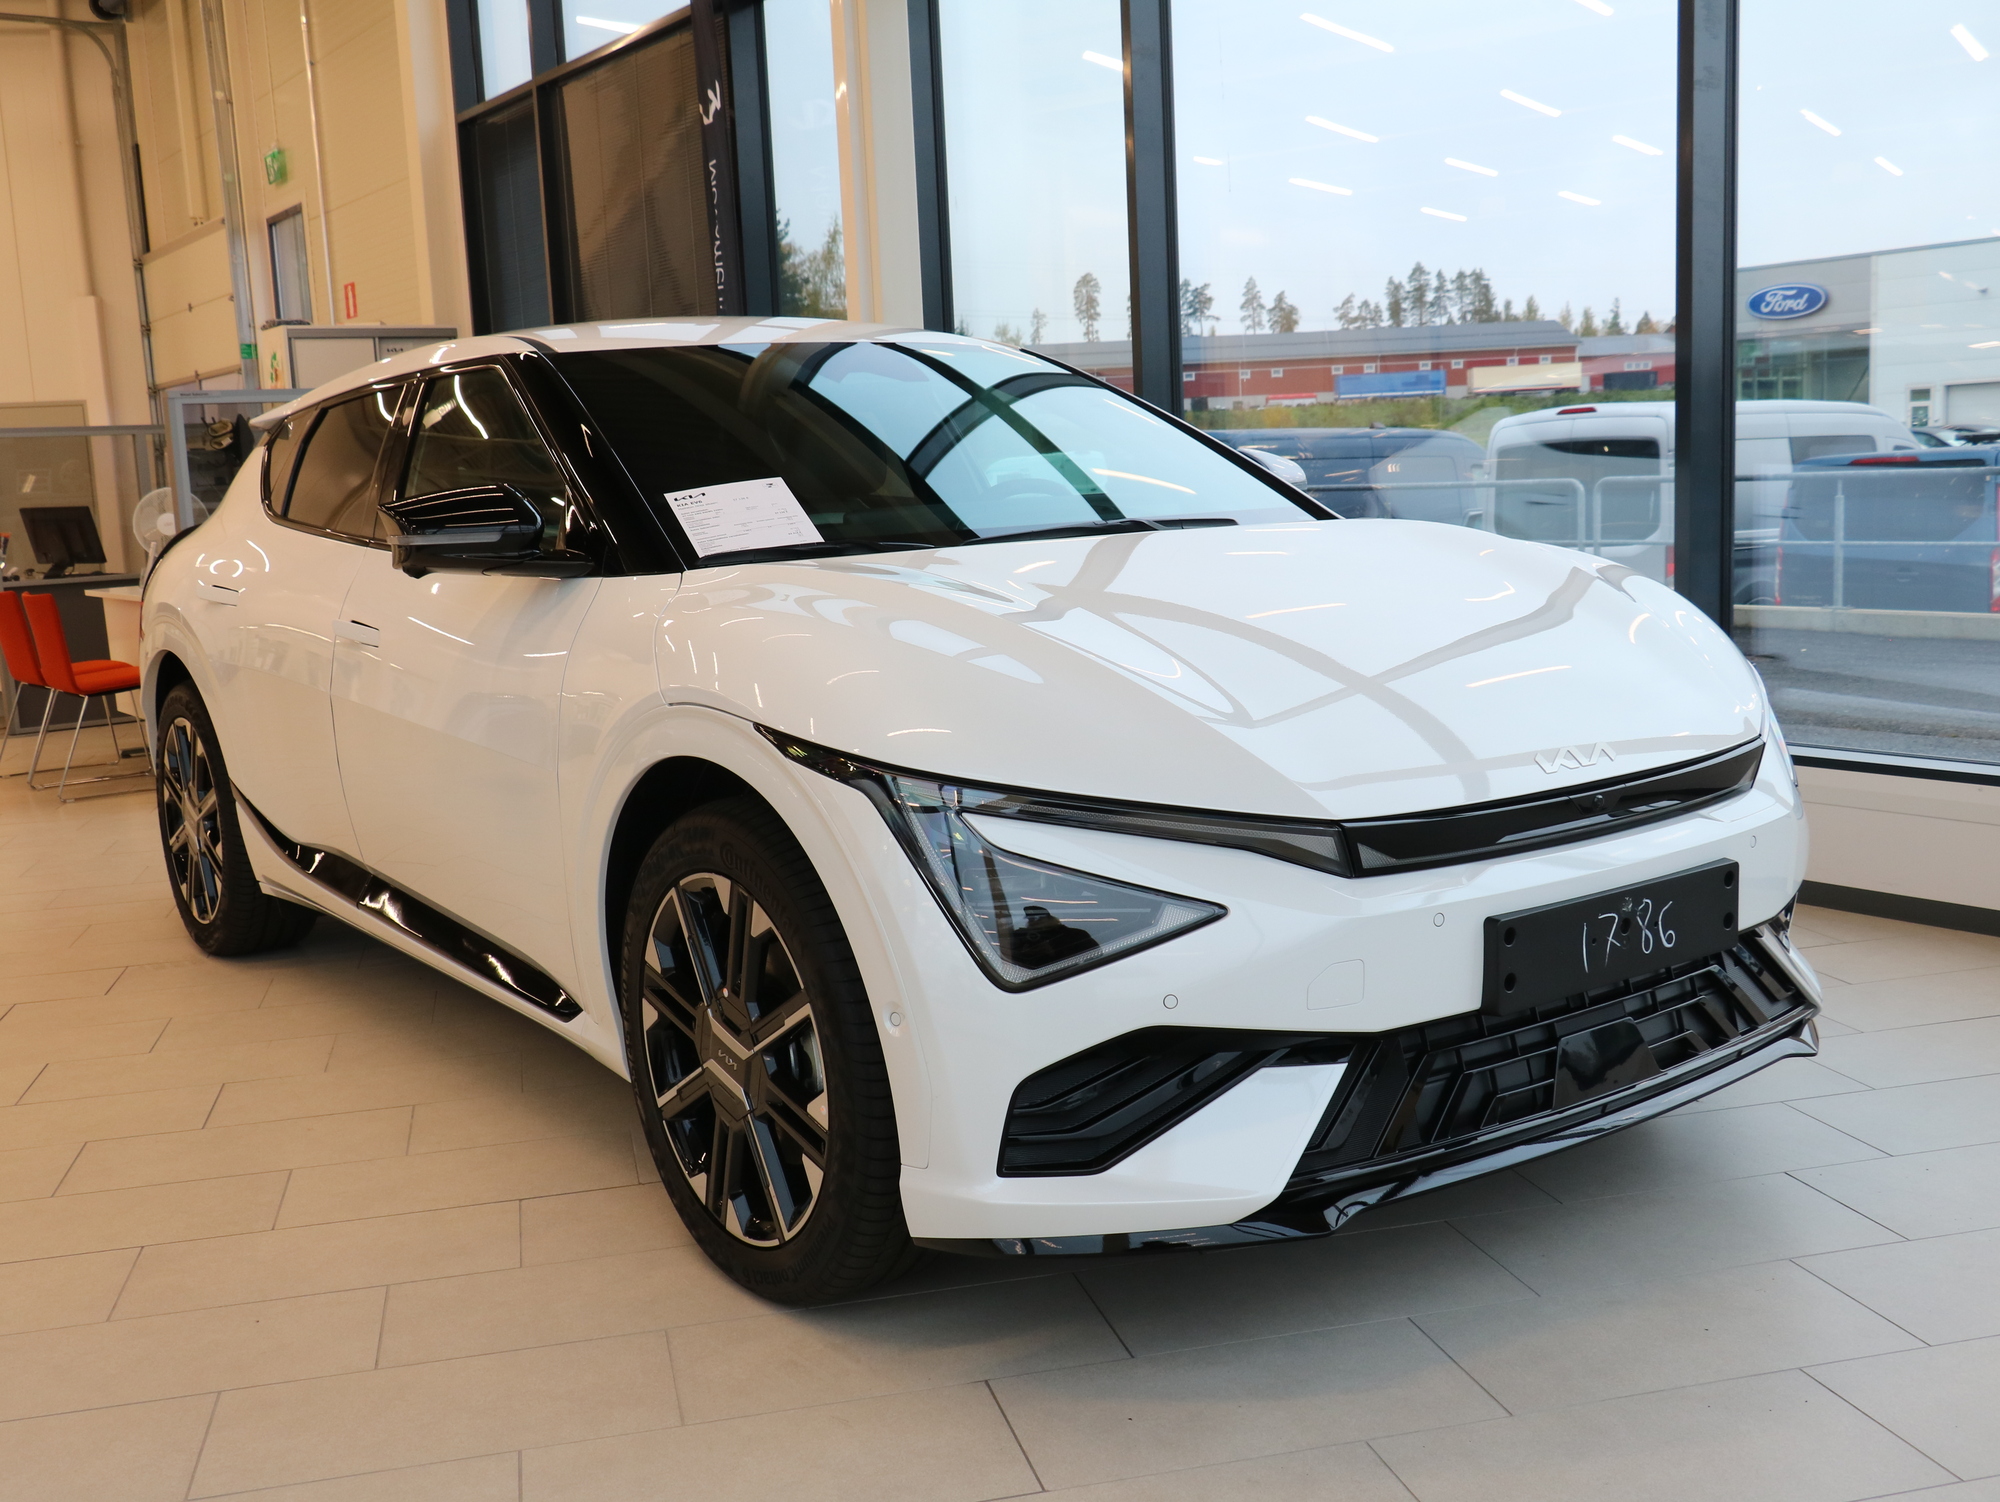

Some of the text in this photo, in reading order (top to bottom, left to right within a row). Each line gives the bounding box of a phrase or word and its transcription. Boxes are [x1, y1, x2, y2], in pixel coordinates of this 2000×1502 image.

[1760, 289, 1810, 313] Ford
[674, 492, 706, 502] KIA
[1533, 741, 1617, 775] KIA
[719, 842, 802, 940] Continental
[1581, 897, 1677, 974] 1786
